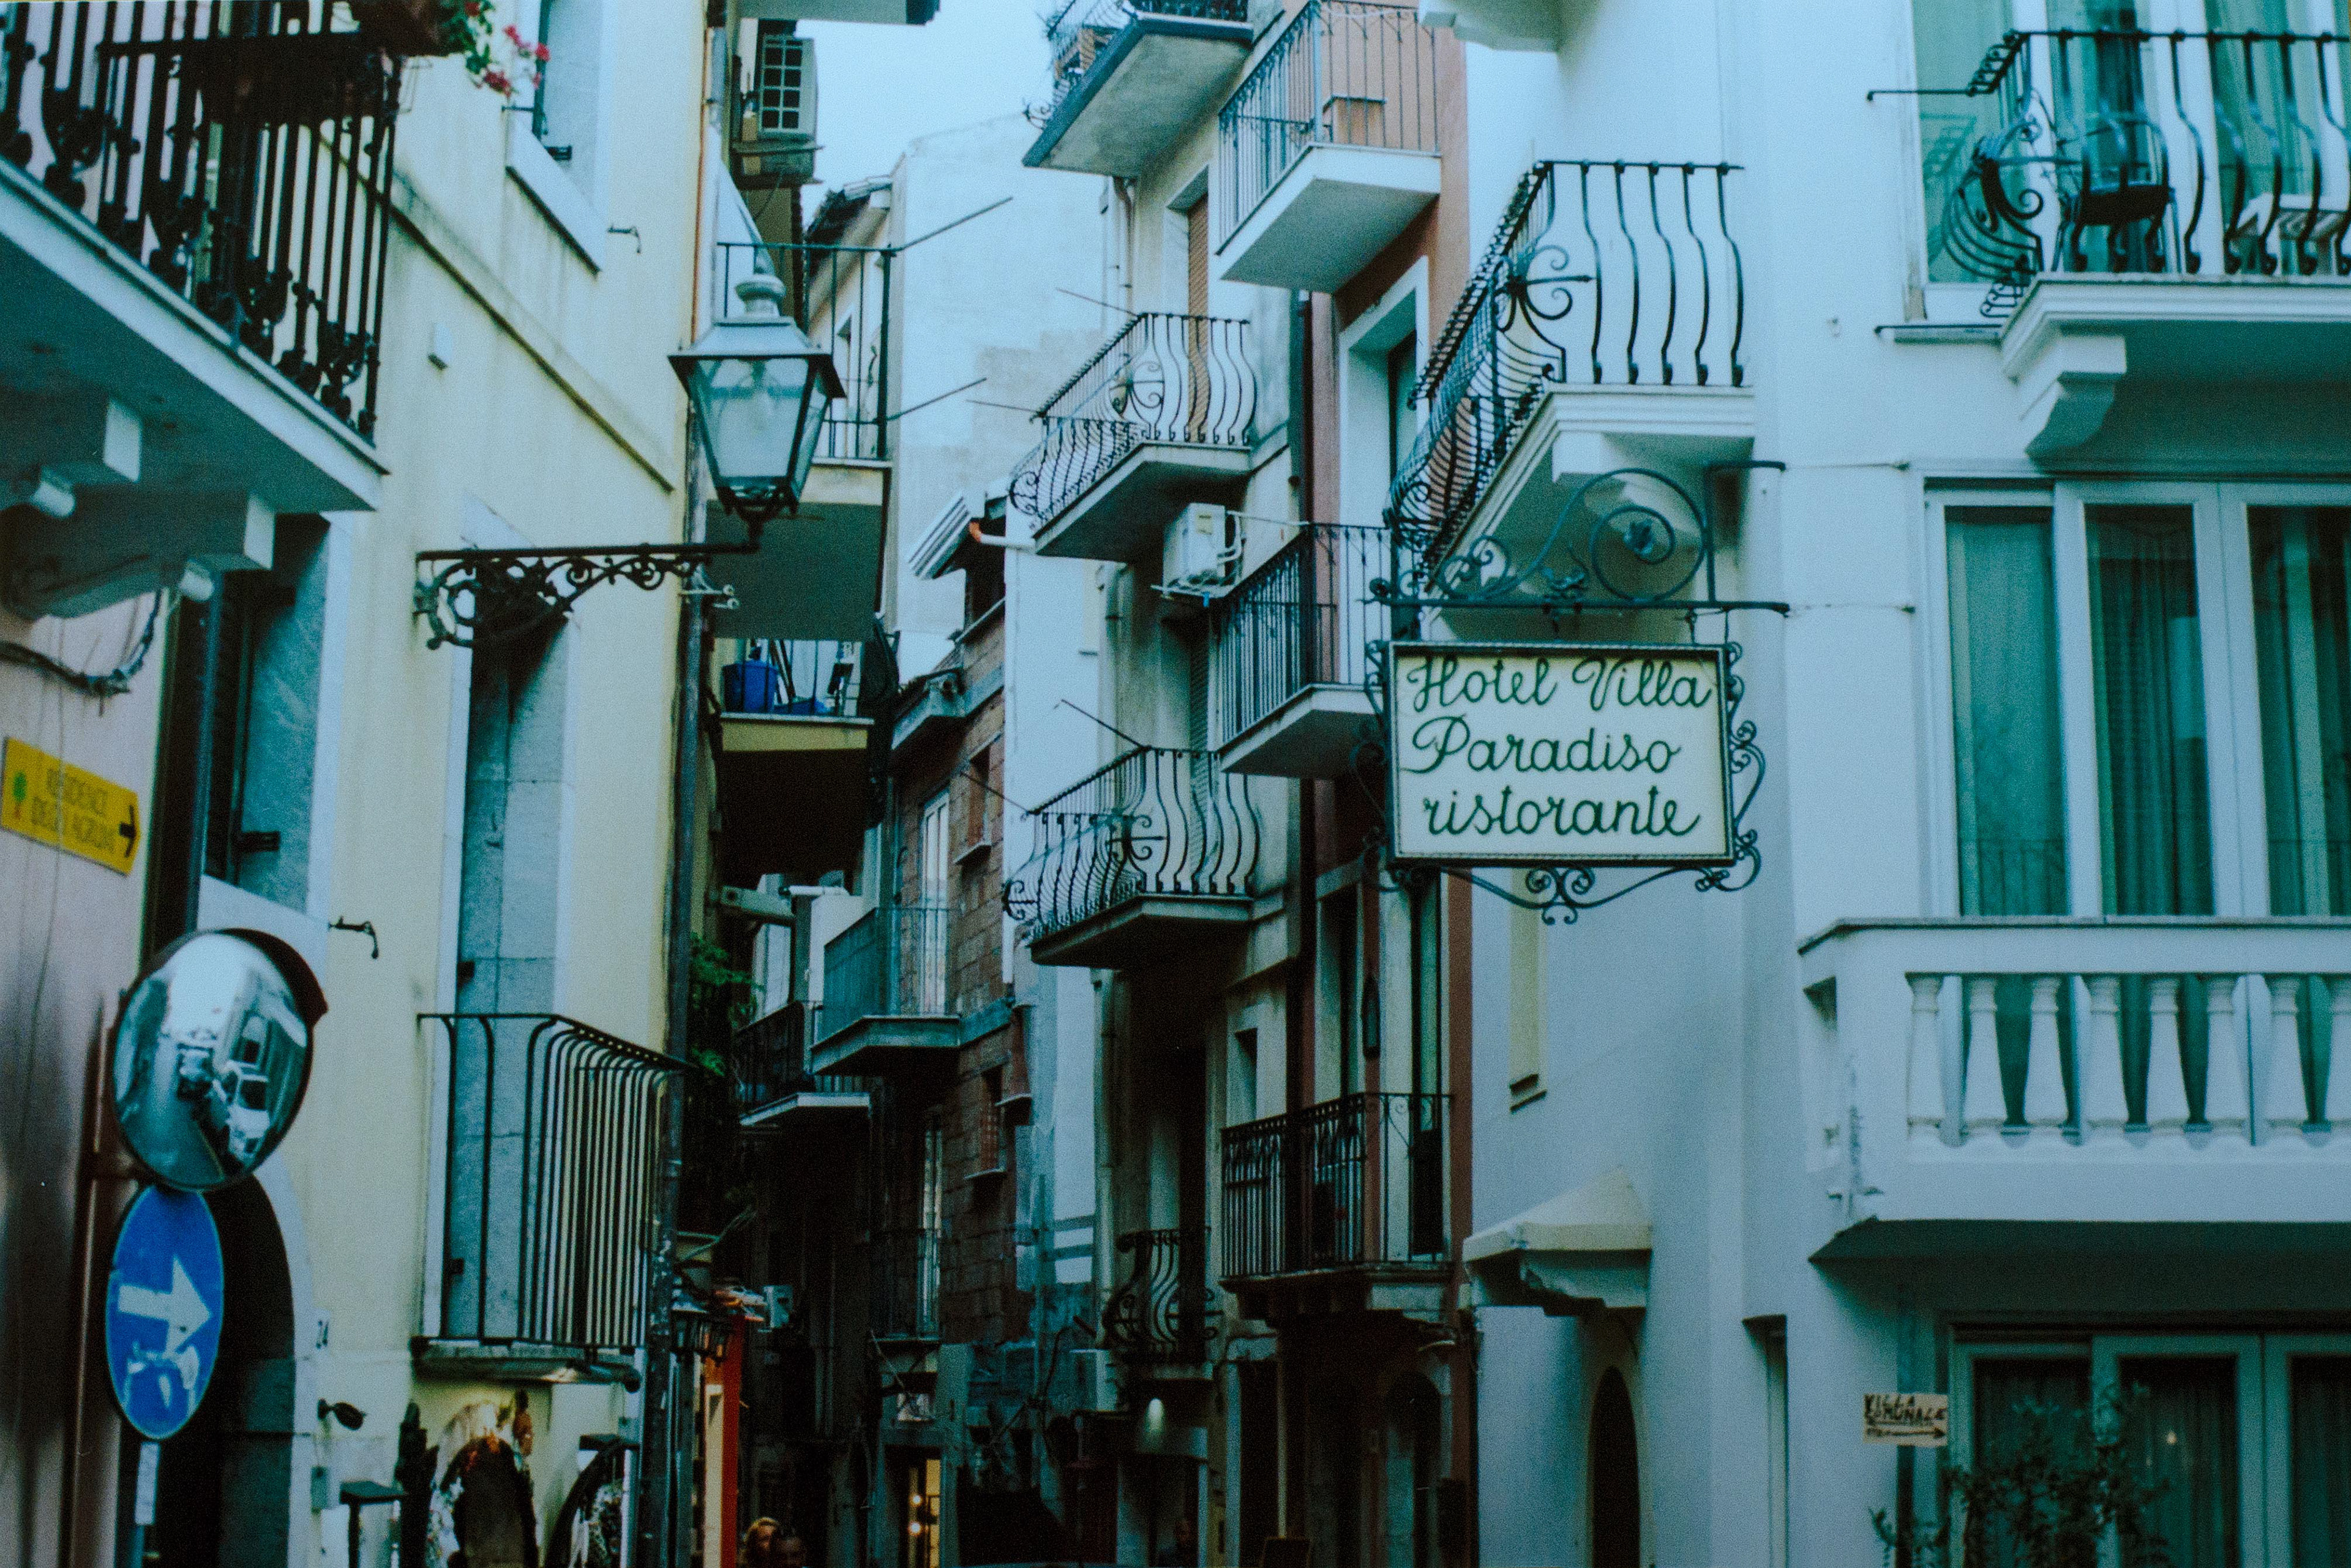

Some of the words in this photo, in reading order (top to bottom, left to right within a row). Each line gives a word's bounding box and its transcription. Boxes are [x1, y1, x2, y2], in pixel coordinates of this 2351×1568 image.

[1407, 655, 1558, 713] Hotel
[1571, 655, 1712, 711] Villa
[1400, 714, 1682, 774] Paradiso
[1422, 785, 1701, 837] ristorante
